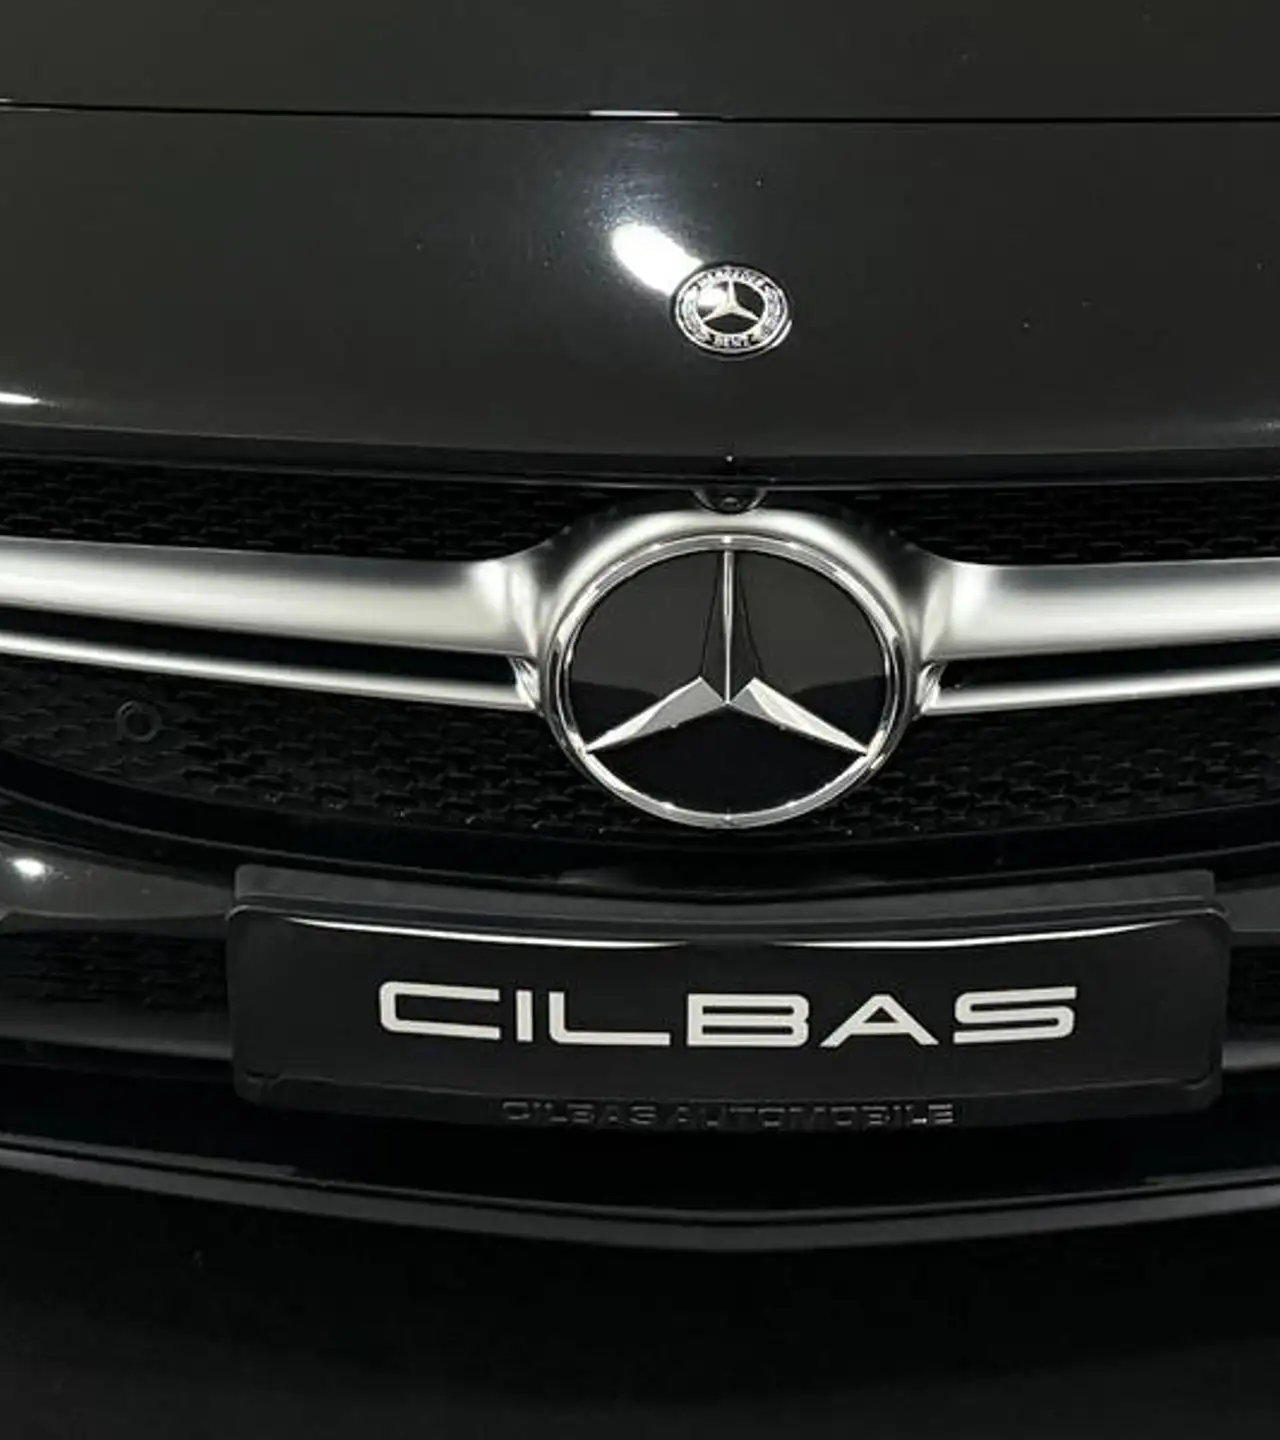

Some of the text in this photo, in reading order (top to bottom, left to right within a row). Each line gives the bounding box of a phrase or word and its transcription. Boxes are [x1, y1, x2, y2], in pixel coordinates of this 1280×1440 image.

[380, 982, 1076, 1047] CILBAS
[502, 1101, 954, 1128] CILBAS AUTOMOBILE
